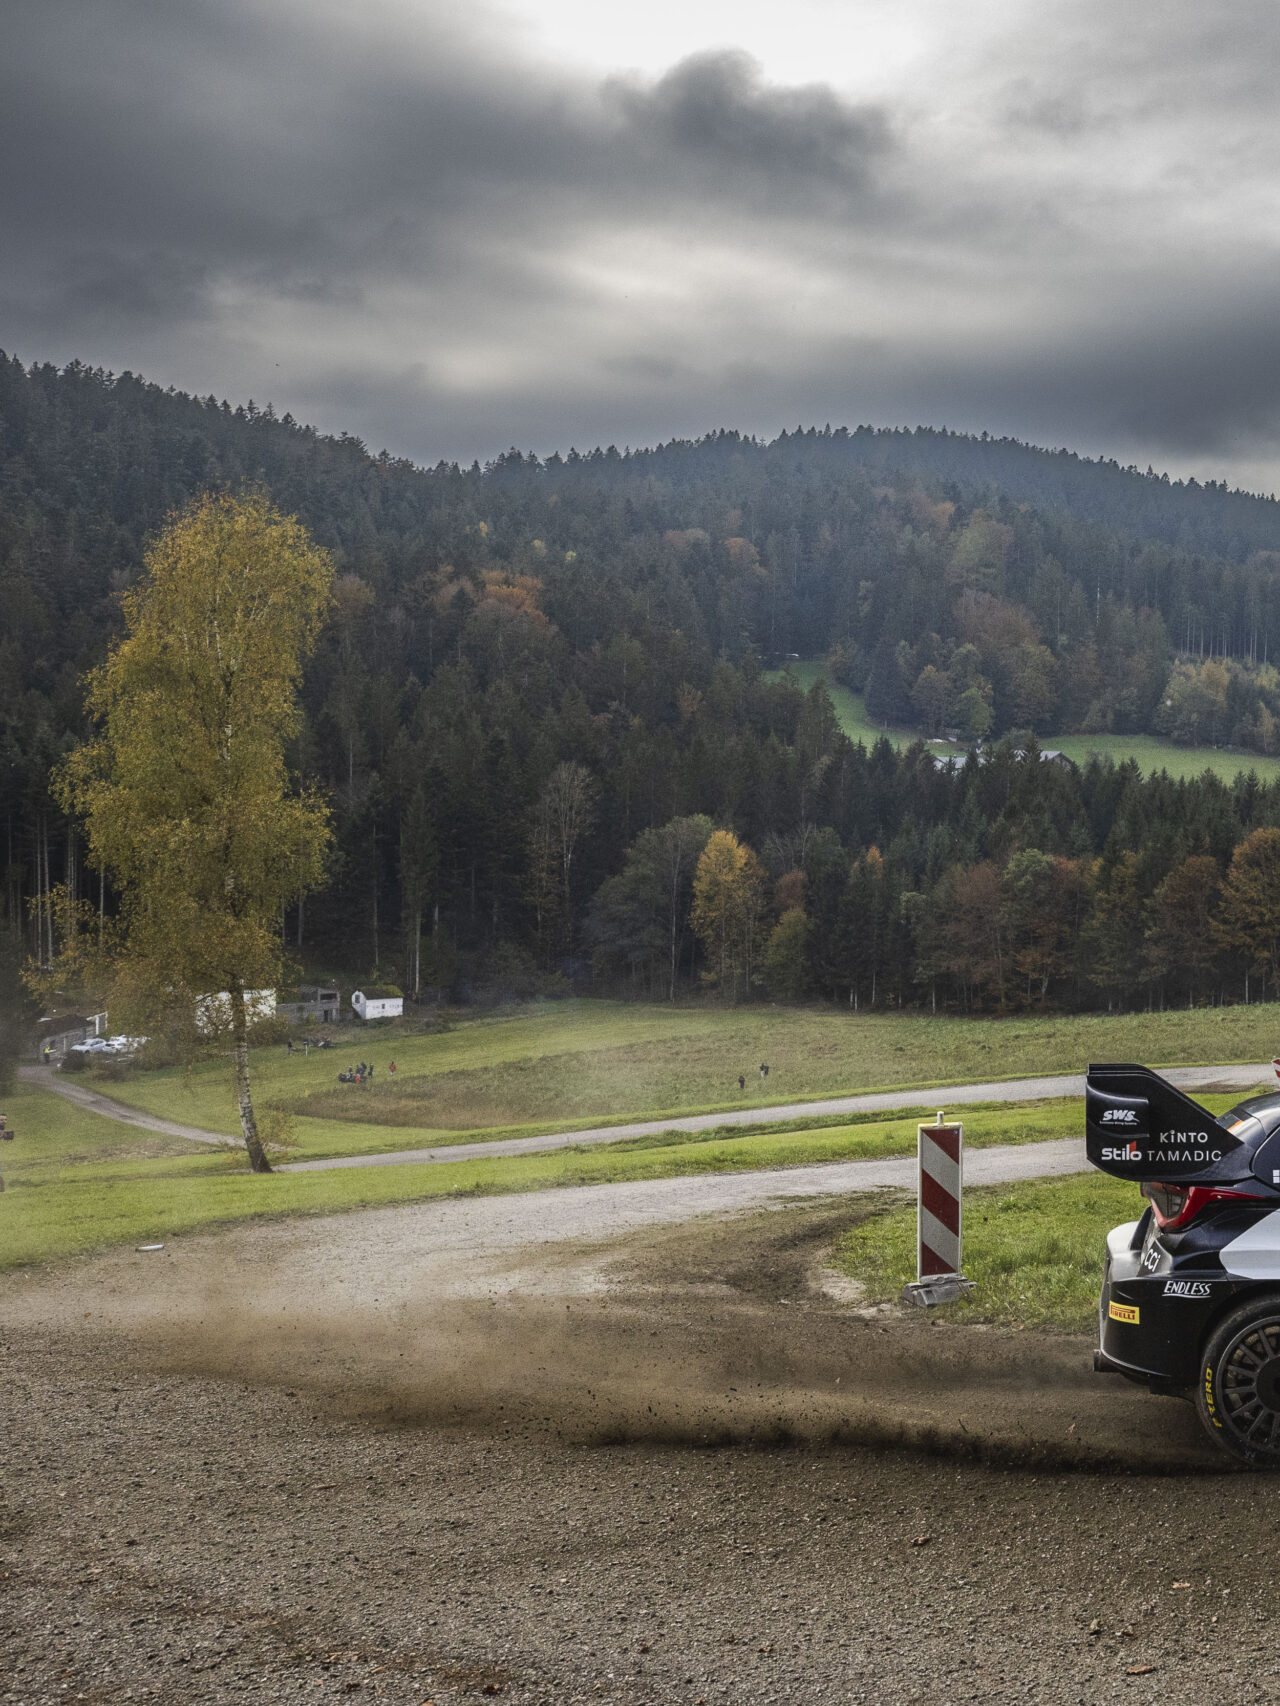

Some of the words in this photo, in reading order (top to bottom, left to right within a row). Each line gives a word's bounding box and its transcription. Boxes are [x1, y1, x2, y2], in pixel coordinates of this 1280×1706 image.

[1101, 1143, 1142, 1160] Stilo
[1147, 1150, 1222, 1161] TAMADIC
[1163, 1281, 1212, 1296] ENDLESS
